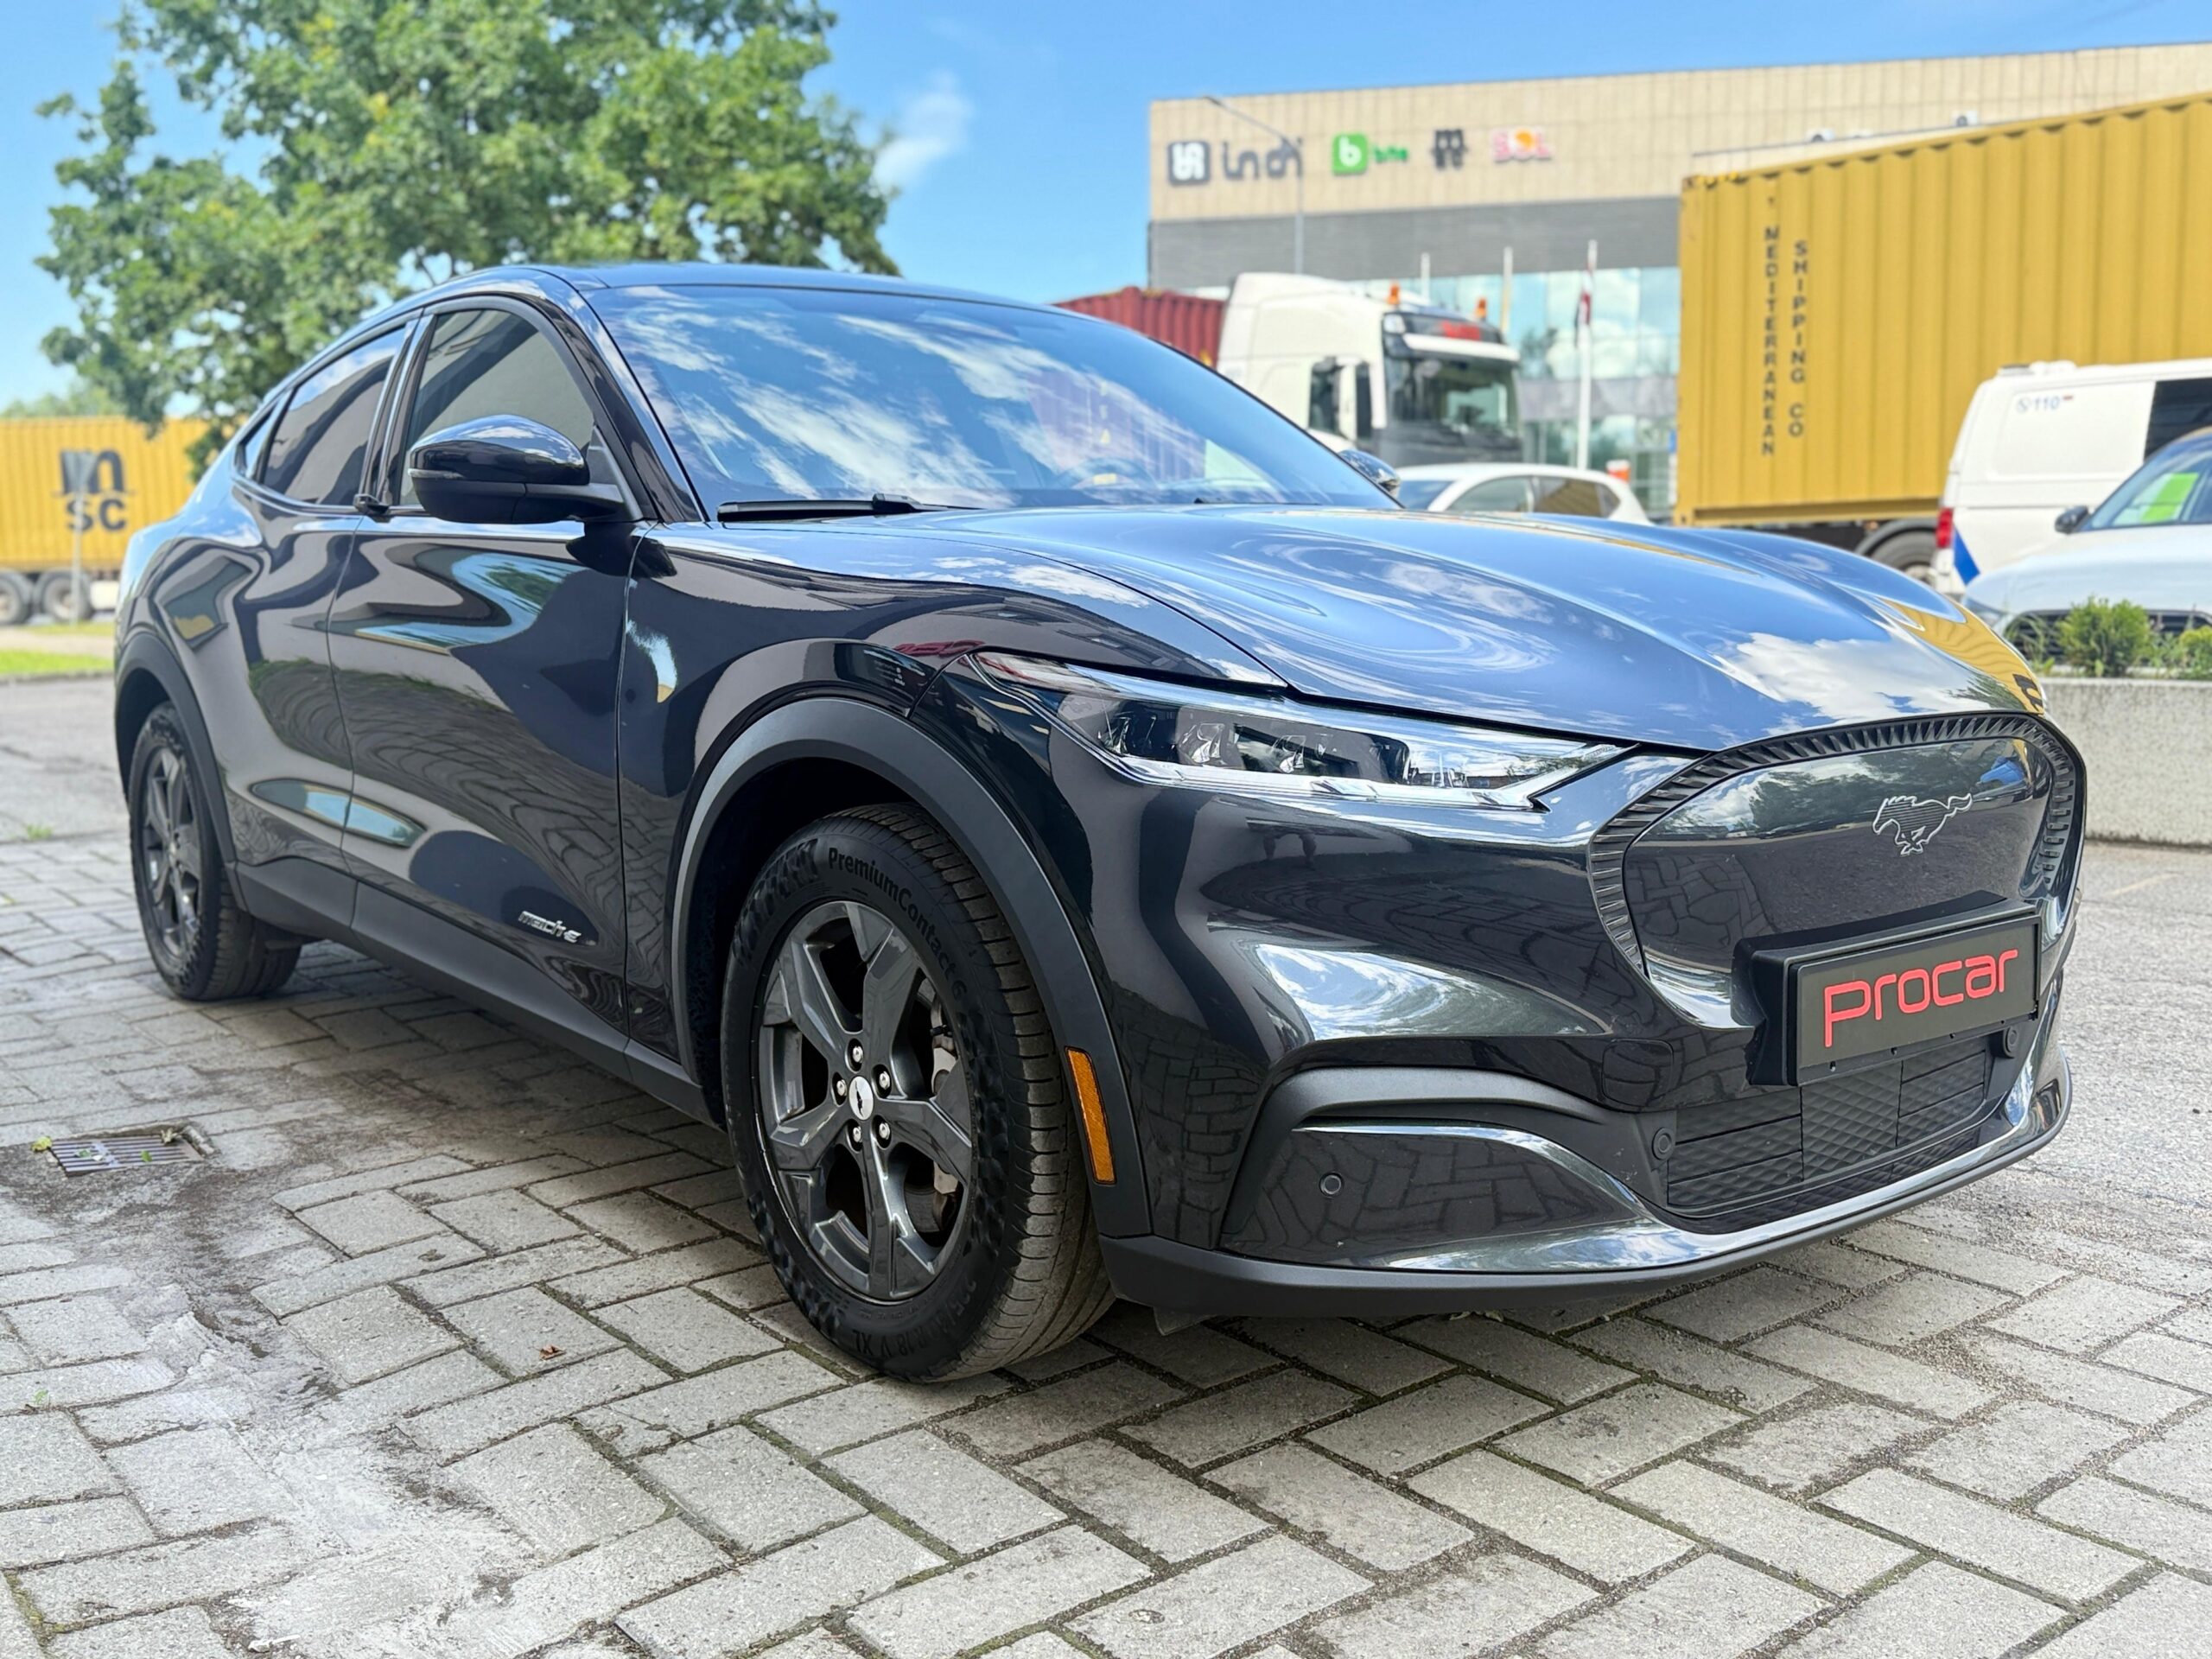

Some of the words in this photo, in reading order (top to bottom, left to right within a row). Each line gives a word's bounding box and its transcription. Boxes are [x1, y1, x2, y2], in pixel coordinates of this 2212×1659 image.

[1762, 225, 1780, 456] MEDITERRANEAN
[1790, 240, 1808, 384] SHIPPING
[1788, 403, 1804, 437] CO
[828, 847, 957, 982] PremiumContact
[1823, 948, 2018, 1048] procar
